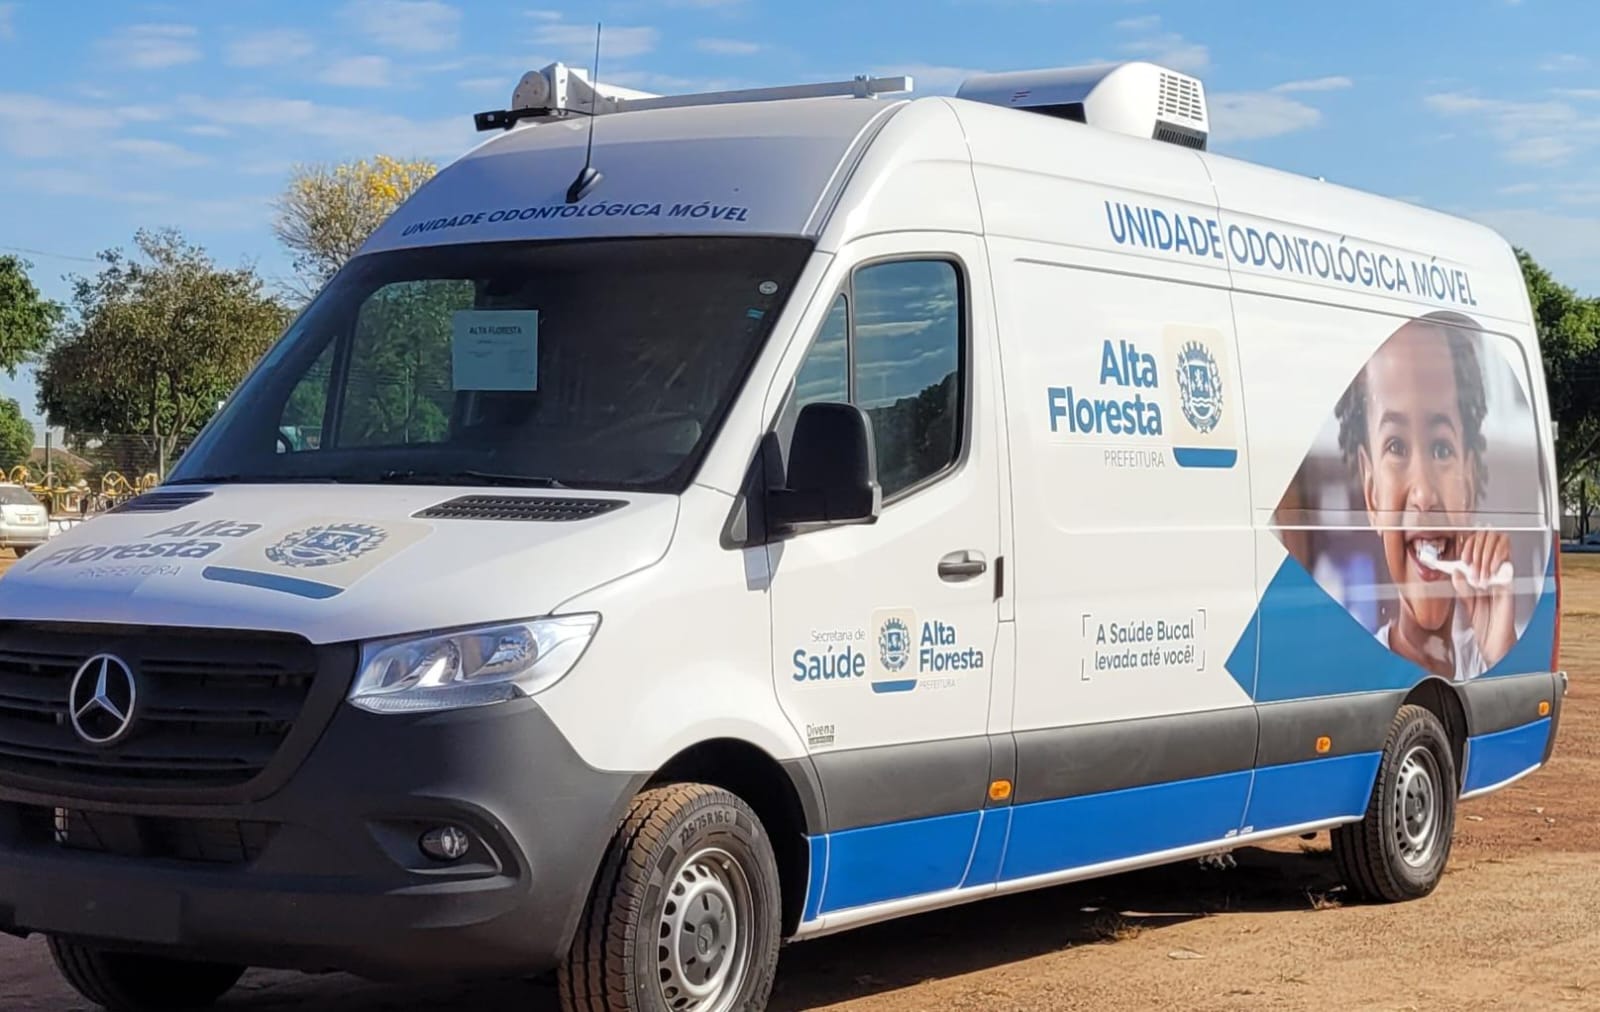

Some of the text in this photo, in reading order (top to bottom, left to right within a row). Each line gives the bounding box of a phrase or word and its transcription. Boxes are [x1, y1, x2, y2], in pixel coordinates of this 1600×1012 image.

[402, 200, 750, 237] UNIDADE ODONTOLÓGICA MÓVEL
[1105, 200, 1478, 307] UNIDADE ODONTOLÓGICA MÓVEL
[1100, 339, 1158, 389] Alta
[1047, 386, 1163, 436] Floresta
[1104, 450, 1165, 468] PREFEITURA
[144, 520, 262, 539] Alta
[26, 538, 224, 573] Floresta
[855, 628, 866, 641] de
[920, 621, 956, 647] Alta
[1096, 618, 1194, 645] A Saúde Bucal
[793, 645, 866, 682] Saúde
[919, 647, 984, 673] Floresta
[1095, 644, 1194, 671] levada até você!
